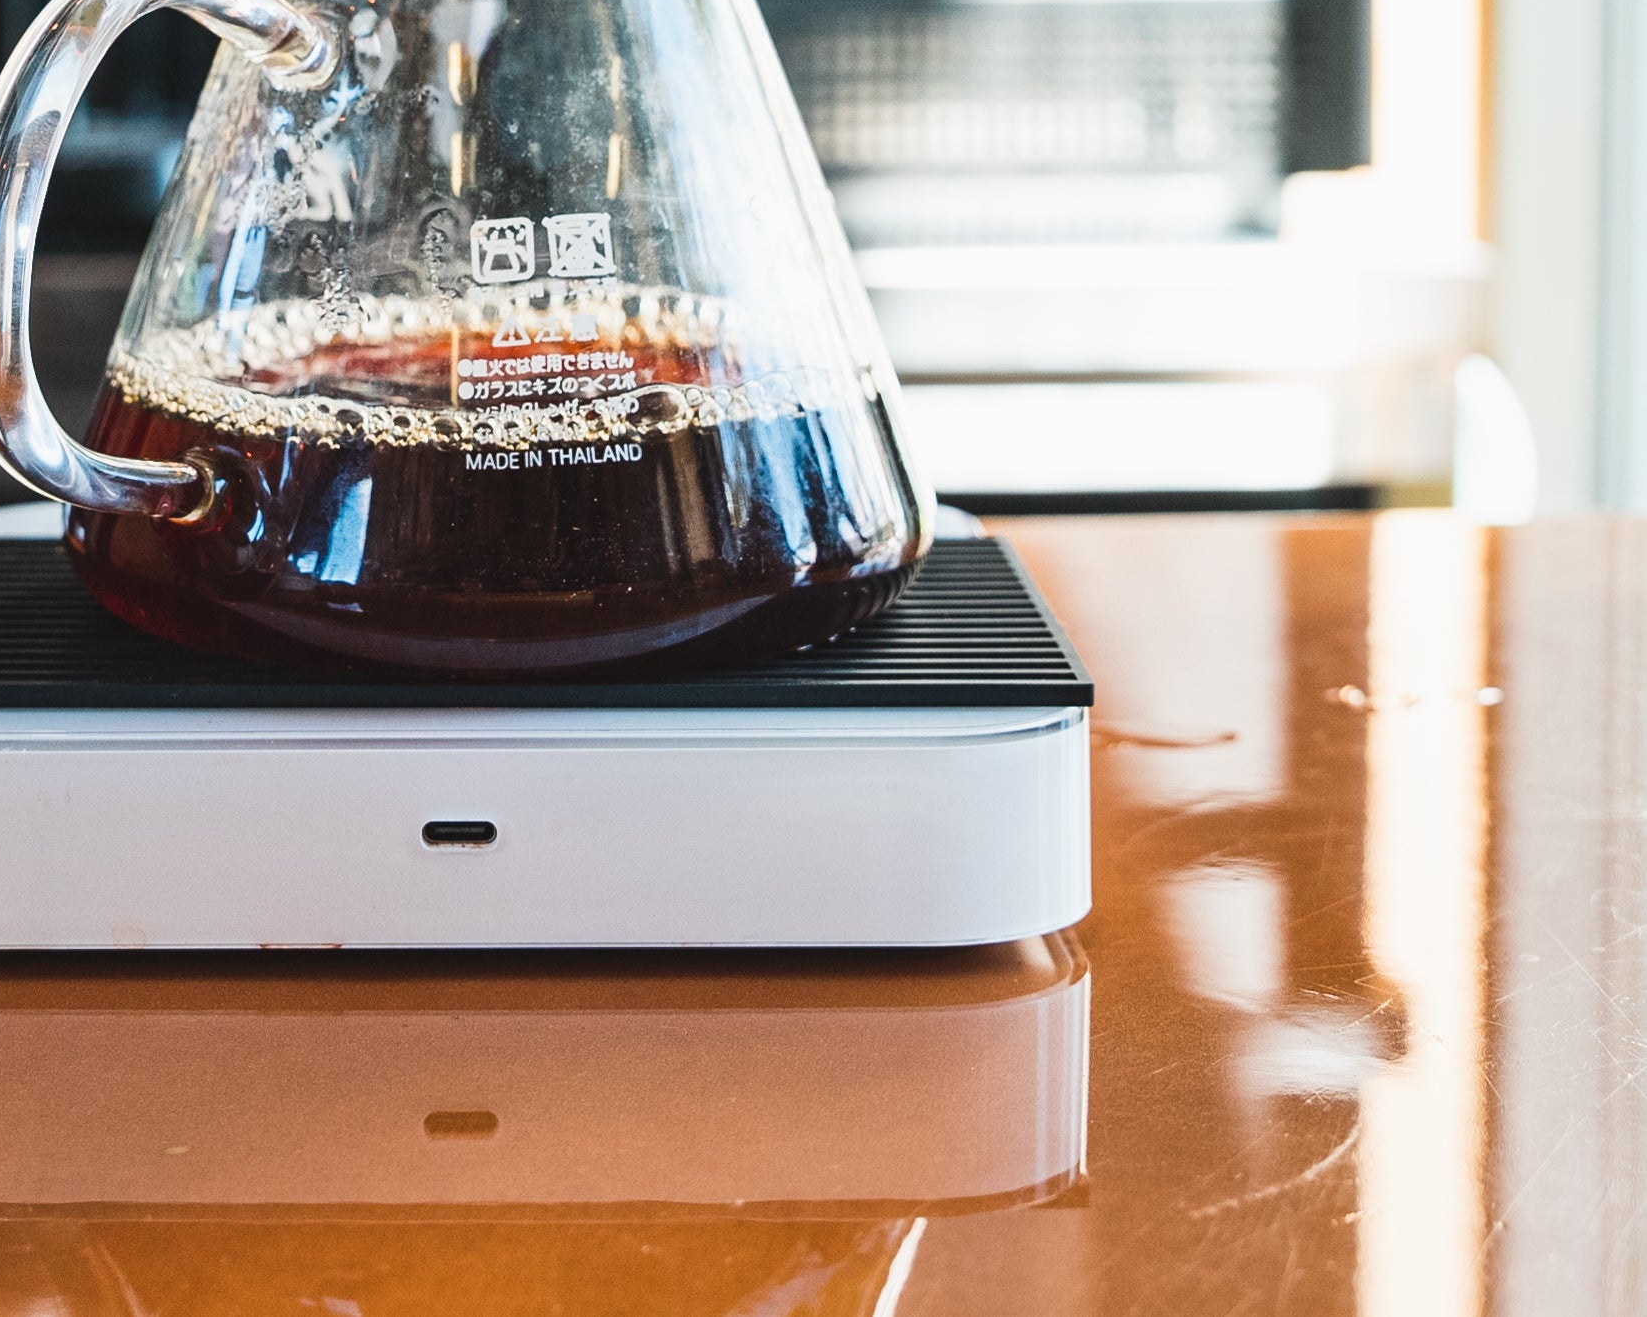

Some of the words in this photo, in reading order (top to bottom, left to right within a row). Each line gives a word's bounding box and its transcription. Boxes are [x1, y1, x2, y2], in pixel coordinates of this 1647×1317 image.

[465, 452, 520, 470] MADE
[524, 450, 543, 468] IN
[547, 443, 643, 466] THAILAND
